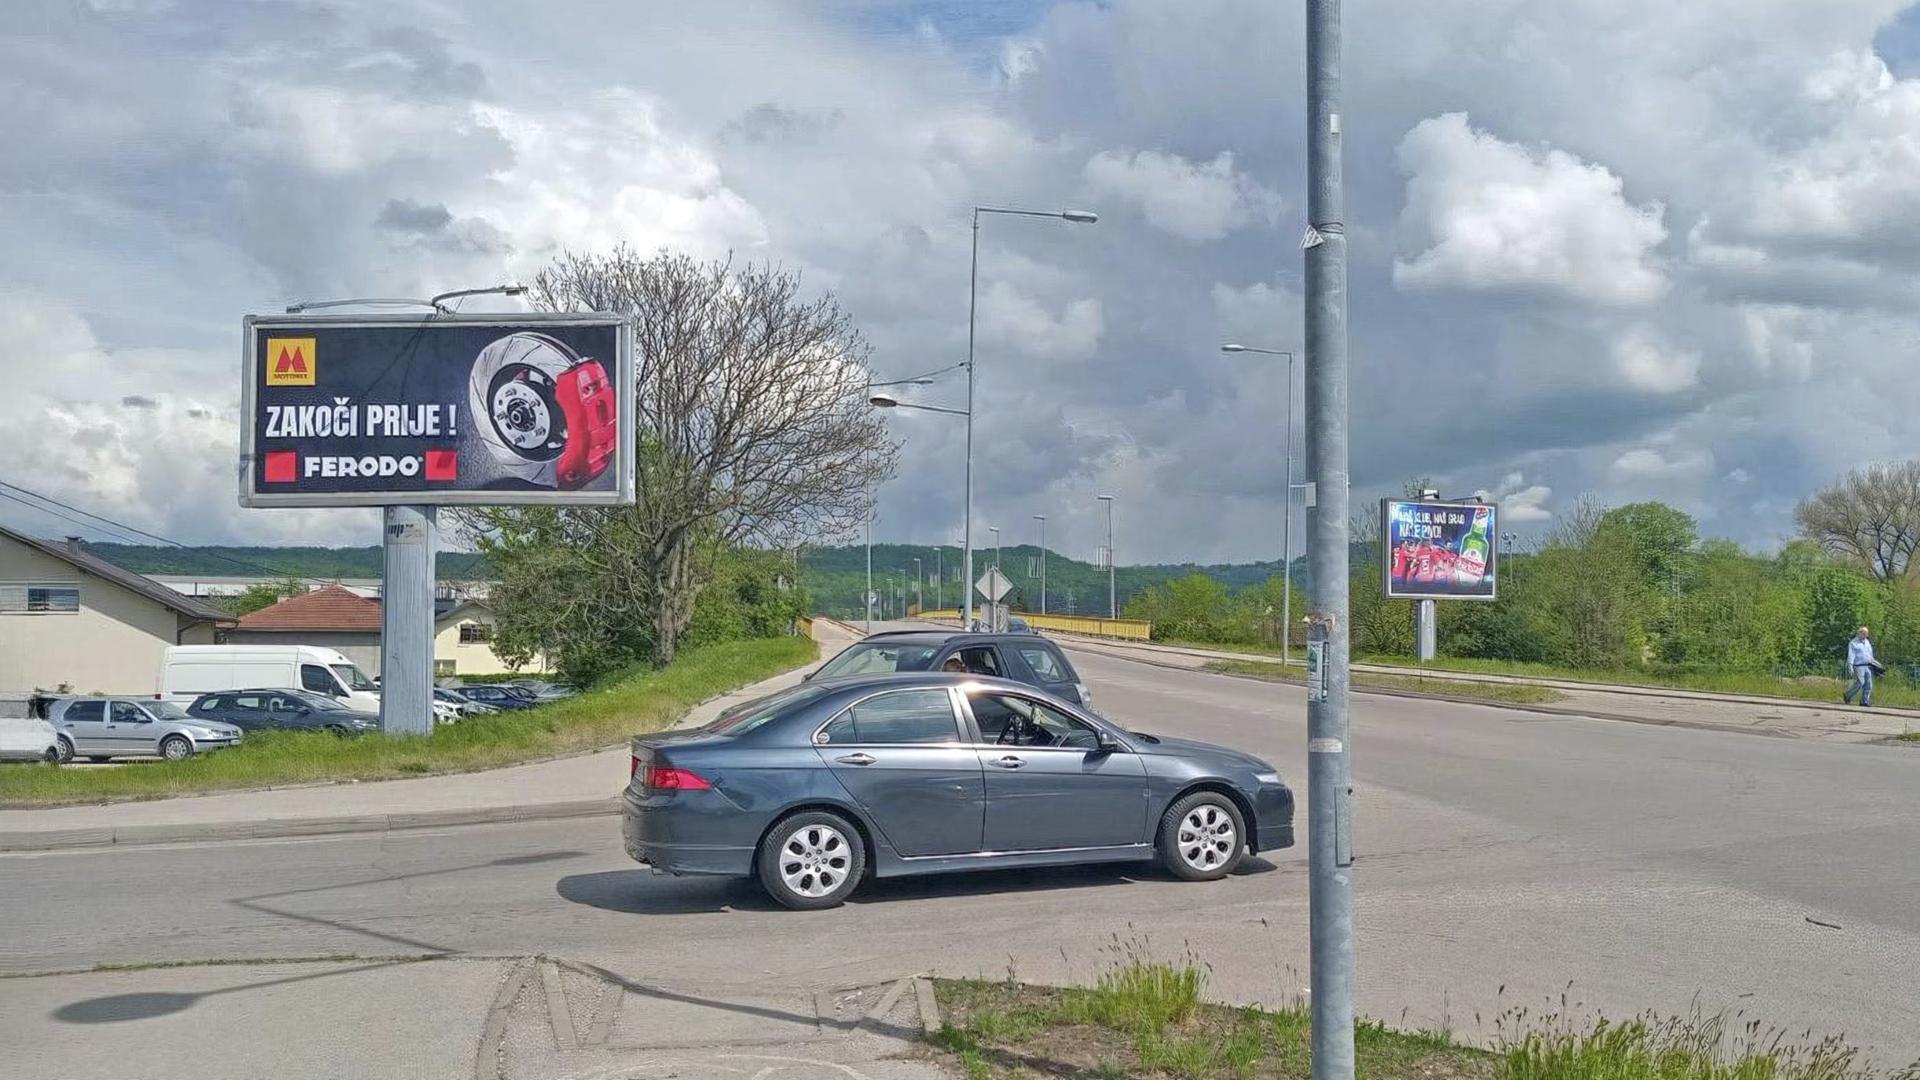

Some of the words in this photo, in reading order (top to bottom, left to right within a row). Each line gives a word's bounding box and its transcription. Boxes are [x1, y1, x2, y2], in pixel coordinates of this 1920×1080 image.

[265, 397, 358, 437] ZAKOČI
[366, 404, 440, 437] PRIJE
[304, 456, 420, 478] FERODO
